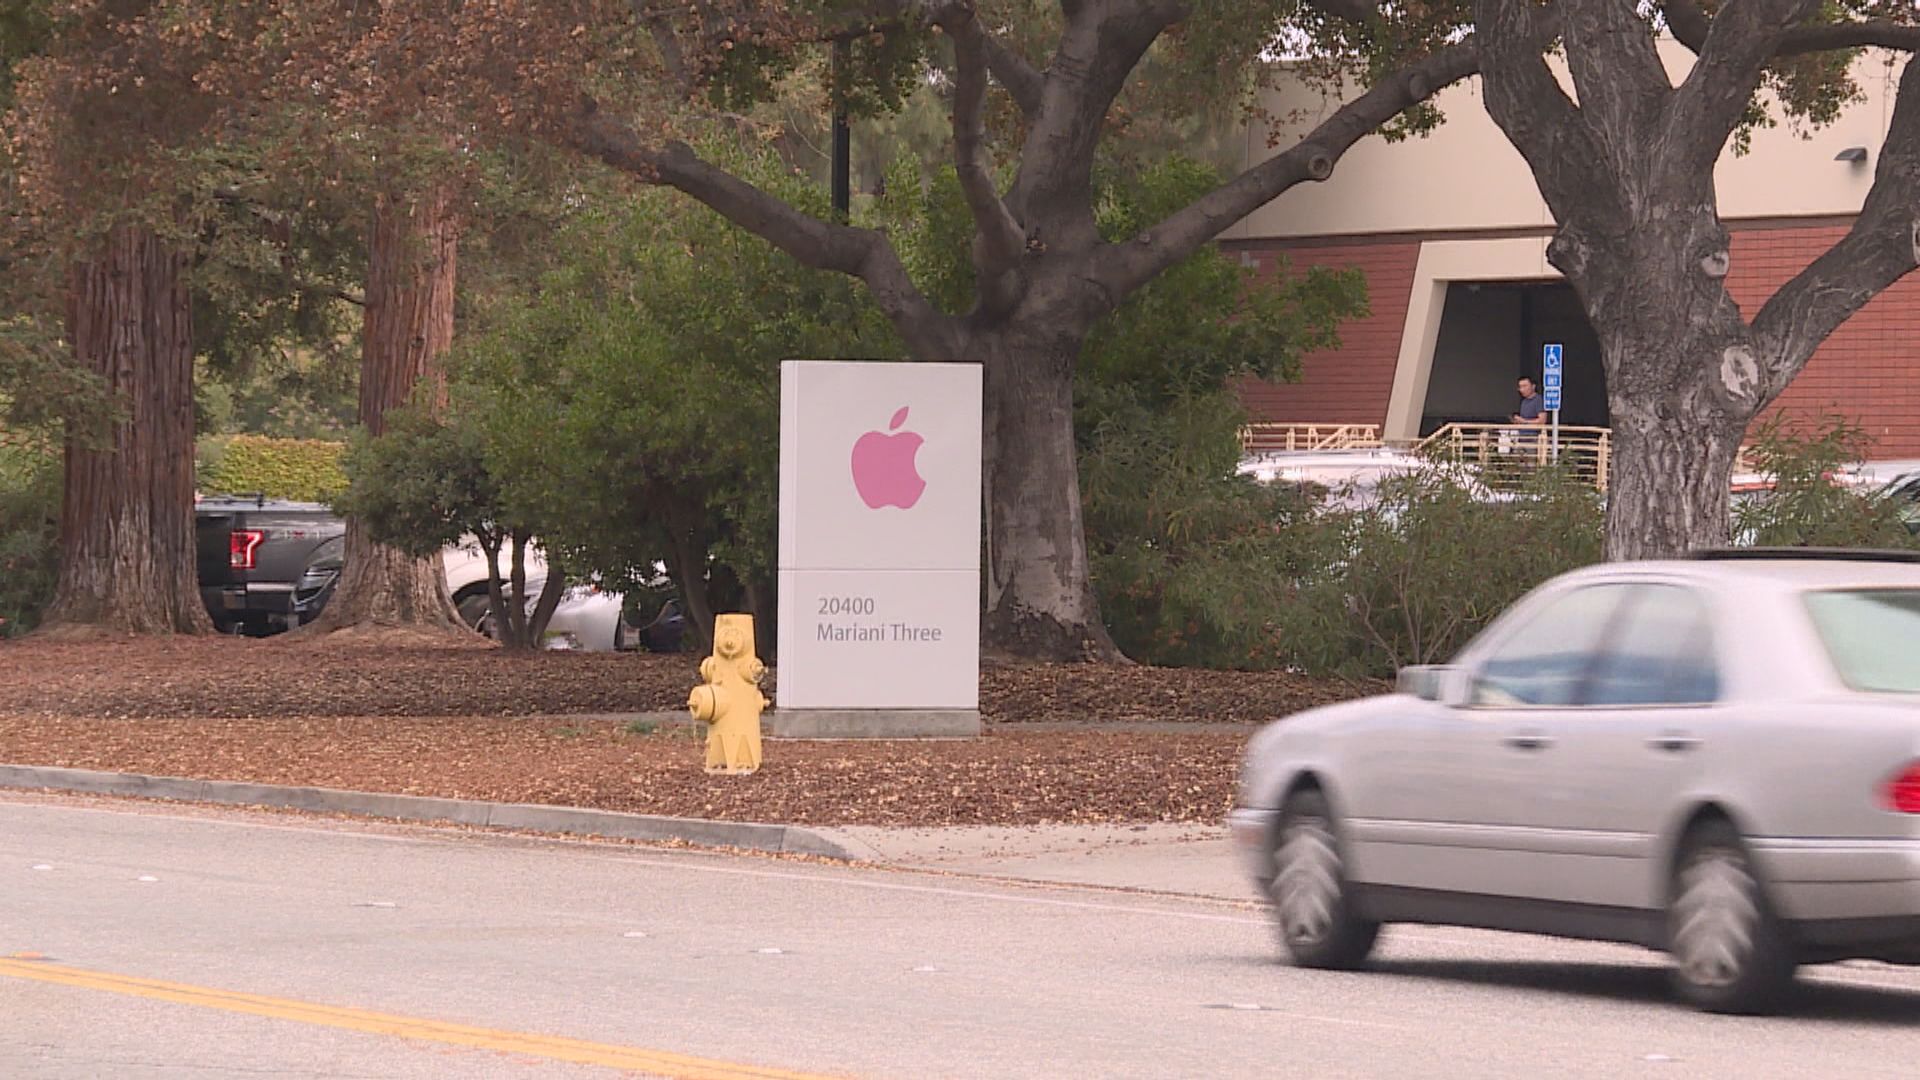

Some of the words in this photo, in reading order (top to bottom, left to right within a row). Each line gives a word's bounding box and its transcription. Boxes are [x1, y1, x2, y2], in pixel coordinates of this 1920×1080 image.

[818, 597, 875, 615] 20400
[816, 622, 885, 641] Mariani
[888, 622, 942, 641] Three
